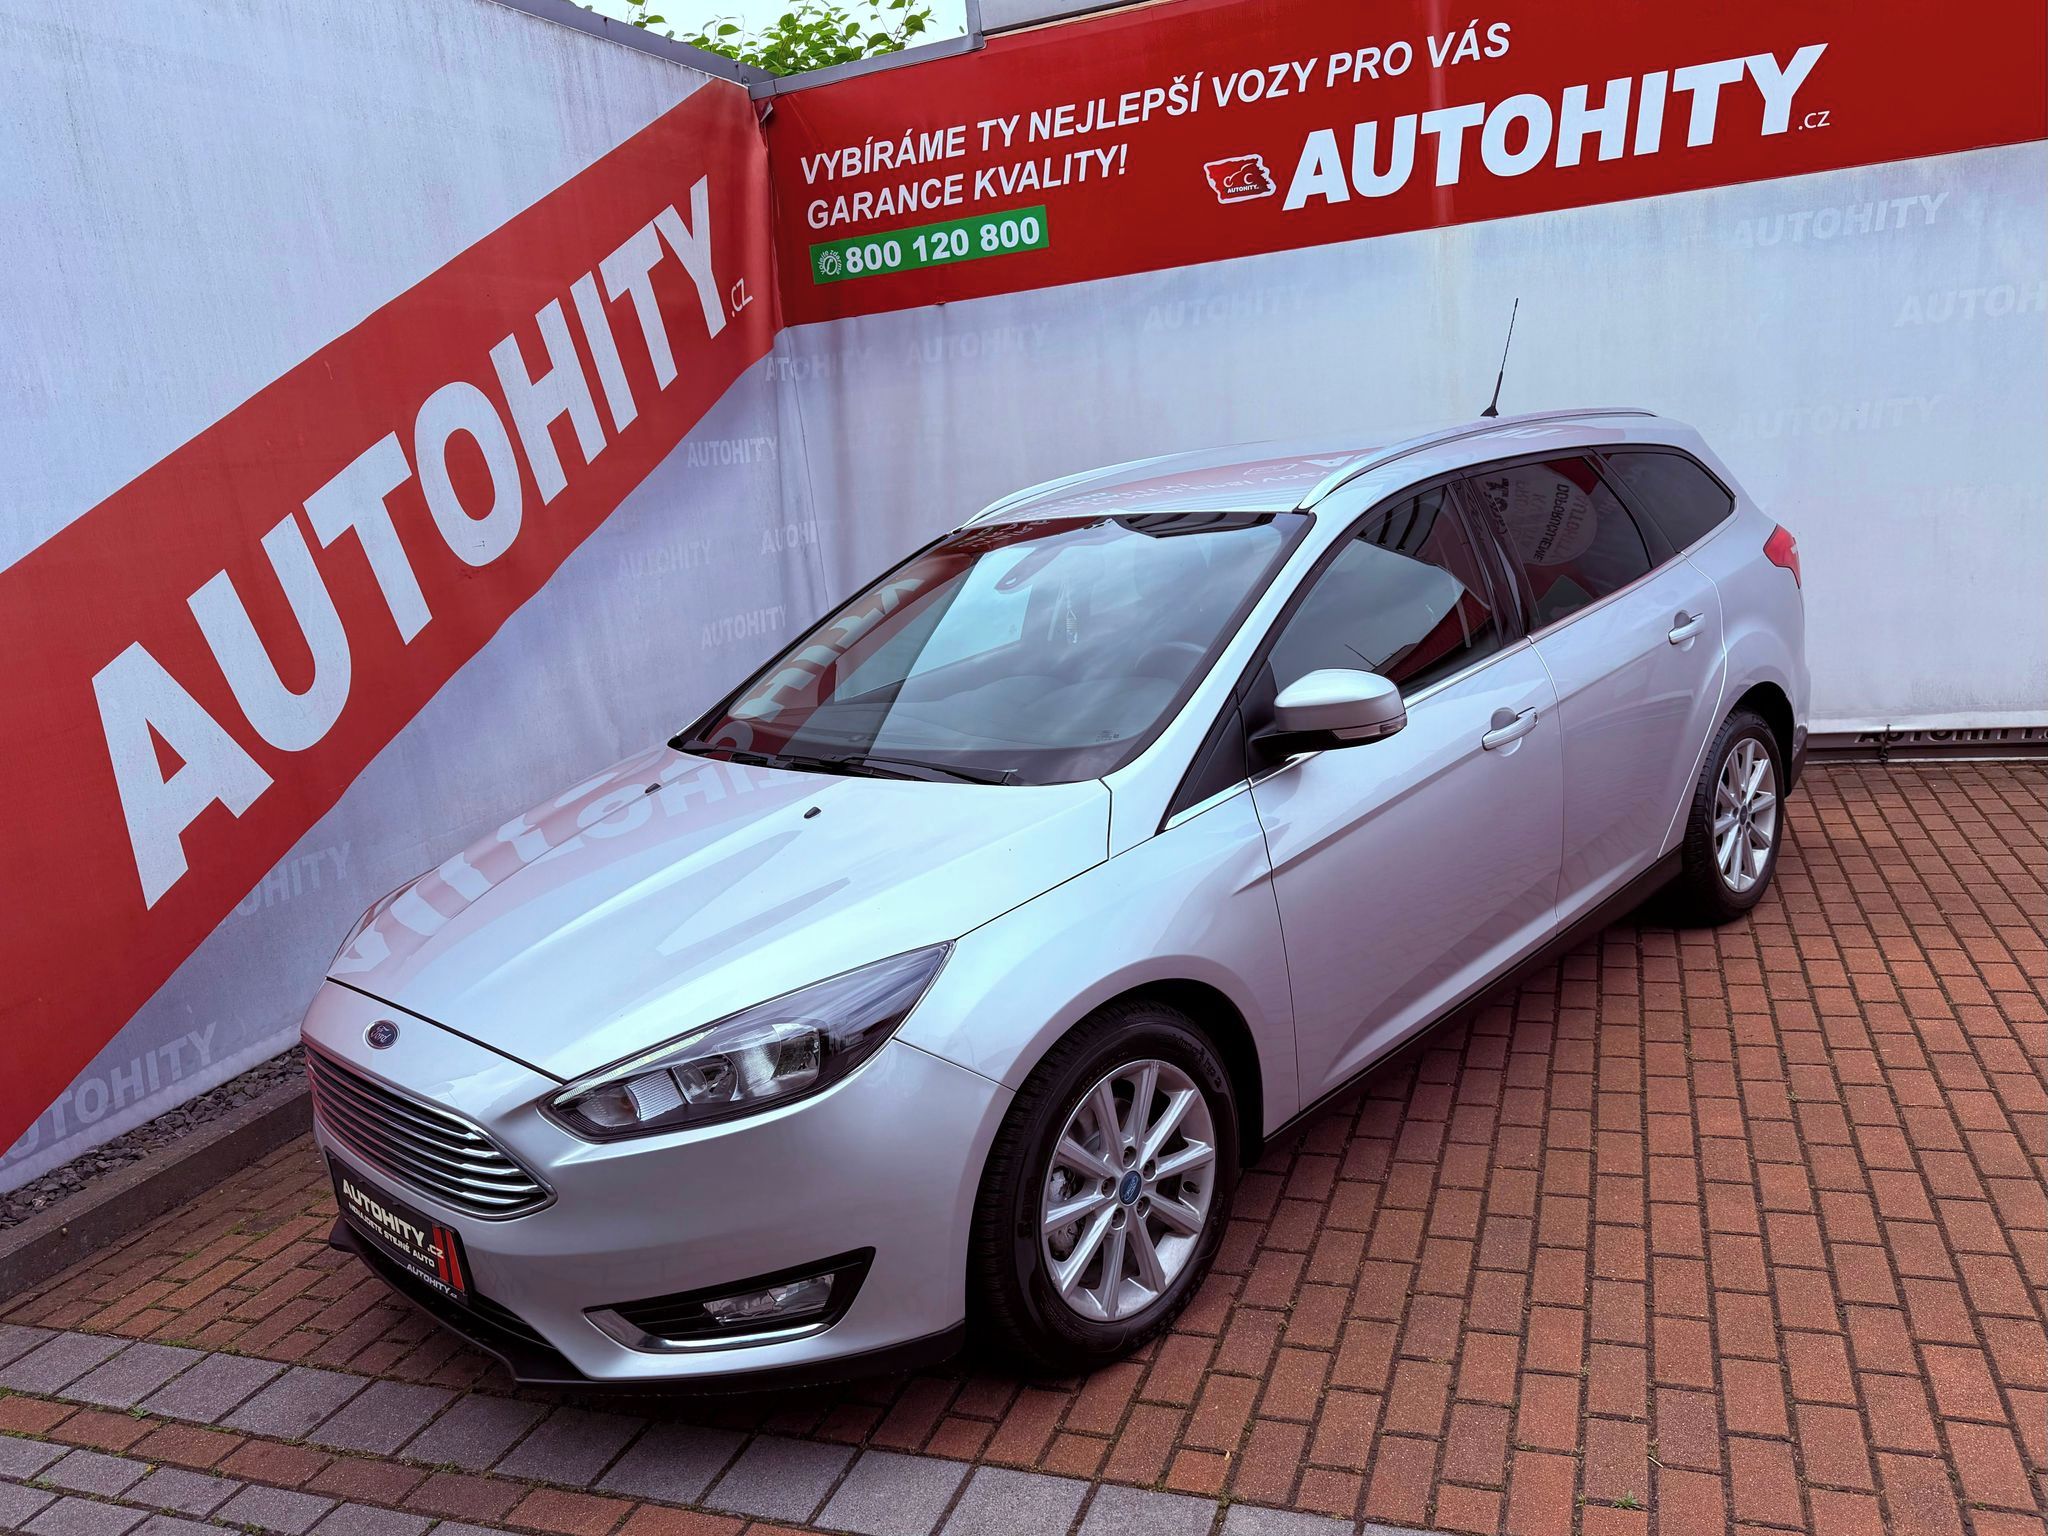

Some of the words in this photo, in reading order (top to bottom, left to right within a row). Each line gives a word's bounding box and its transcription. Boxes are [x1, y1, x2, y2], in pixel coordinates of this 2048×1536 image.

[800, 126, 967, 185] VYBÍRÁME
[976, 114, 1021, 152] TY
[1028, 71, 1204, 143] NEJLEPŠÍ
[1211, 57, 1318, 108] VOZY
[1326, 40, 1413, 88] PRO
[1426, 18, 1511, 69] VÁS
[1282, 42, 1829, 211] AUTOHITY
[807, 173, 964, 229] GARANCE
[974, 143, 1128, 201] KVALITY!
[845, 240, 902, 273] 800
[912, 228, 970, 262] 120
[979, 216, 1040, 252] 800
[1732, 191, 1950, 249] AUTOHITY
[687, 436, 778, 468] AUTOHITY
[91, 174, 727, 911] AUTOHITY
[701, 605, 788, 650] AUTOHITY
[342, 1178, 424, 1248] AUTOHITY
[406, 1263, 451, 1294] AUTOHITY
[412, 1249, 435, 1268] AUTO
